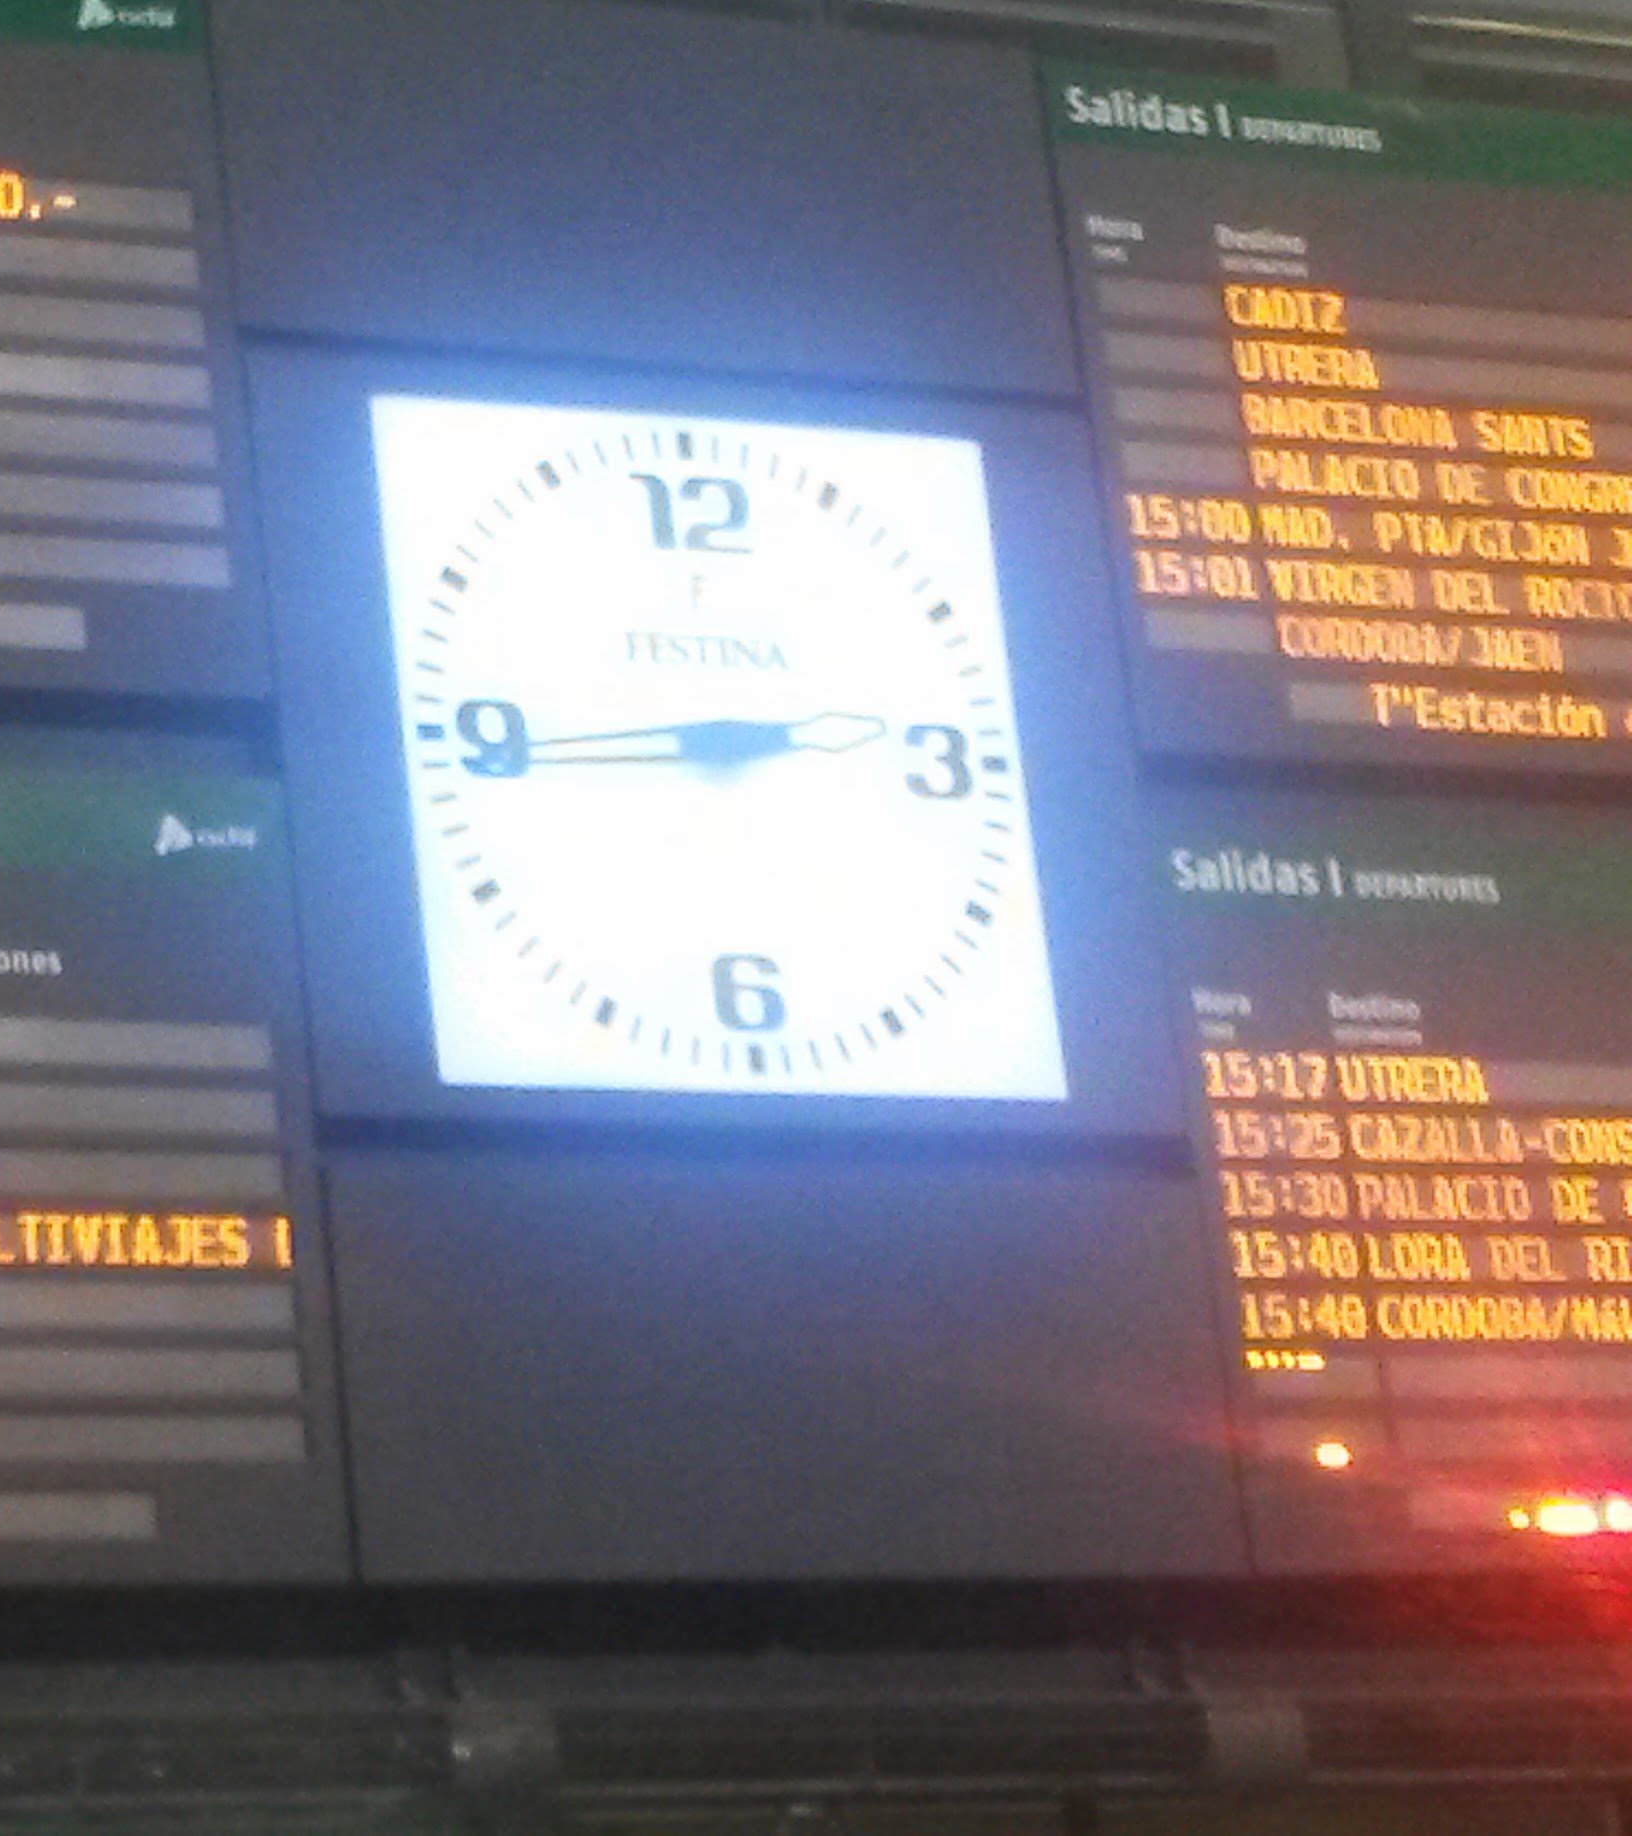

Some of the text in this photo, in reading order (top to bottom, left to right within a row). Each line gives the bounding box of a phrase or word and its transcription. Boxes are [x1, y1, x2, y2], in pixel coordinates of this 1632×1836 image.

[1065, 84, 1211, 138] Salidas
[1232, 340, 1382, 391] UTRERA
[1241, 392, 1595, 462] BARCELONA SANTS
[1250, 447, 1420, 502] PALACIO
[1435, 458, 1494, 508] DE
[628, 473, 753, 553] 12
[1124, 492, 1253, 545] 15:00
[1133, 549, 1260, 601] 15:01
[1264, 556, 1416, 612] VIRGEN
[1429, 570, 1511, 616] DEL
[624, 630, 790, 671] FESTINA
[455, 699, 530, 779] 9
[903, 723, 973, 801] 3
[1172, 847, 1321, 898] Salidas
[709, 953, 788, 1034] 6
[1200, 1050, 1491, 1104] 15:17 UTRERA
[1214, 1108, 1343, 1160] 15:25
[1218, 1169, 1349, 1220] 15:30
[1352, 1172, 1533, 1223] PALACIO
[1548, 1174, 1607, 1226] DE
[1231, 1229, 1360, 1280] 15:40
[1364, 1231, 1471, 1281] LORA
[1485, 1232, 1568, 1284] DEL
[1240, 1291, 1368, 1341] 15:40
